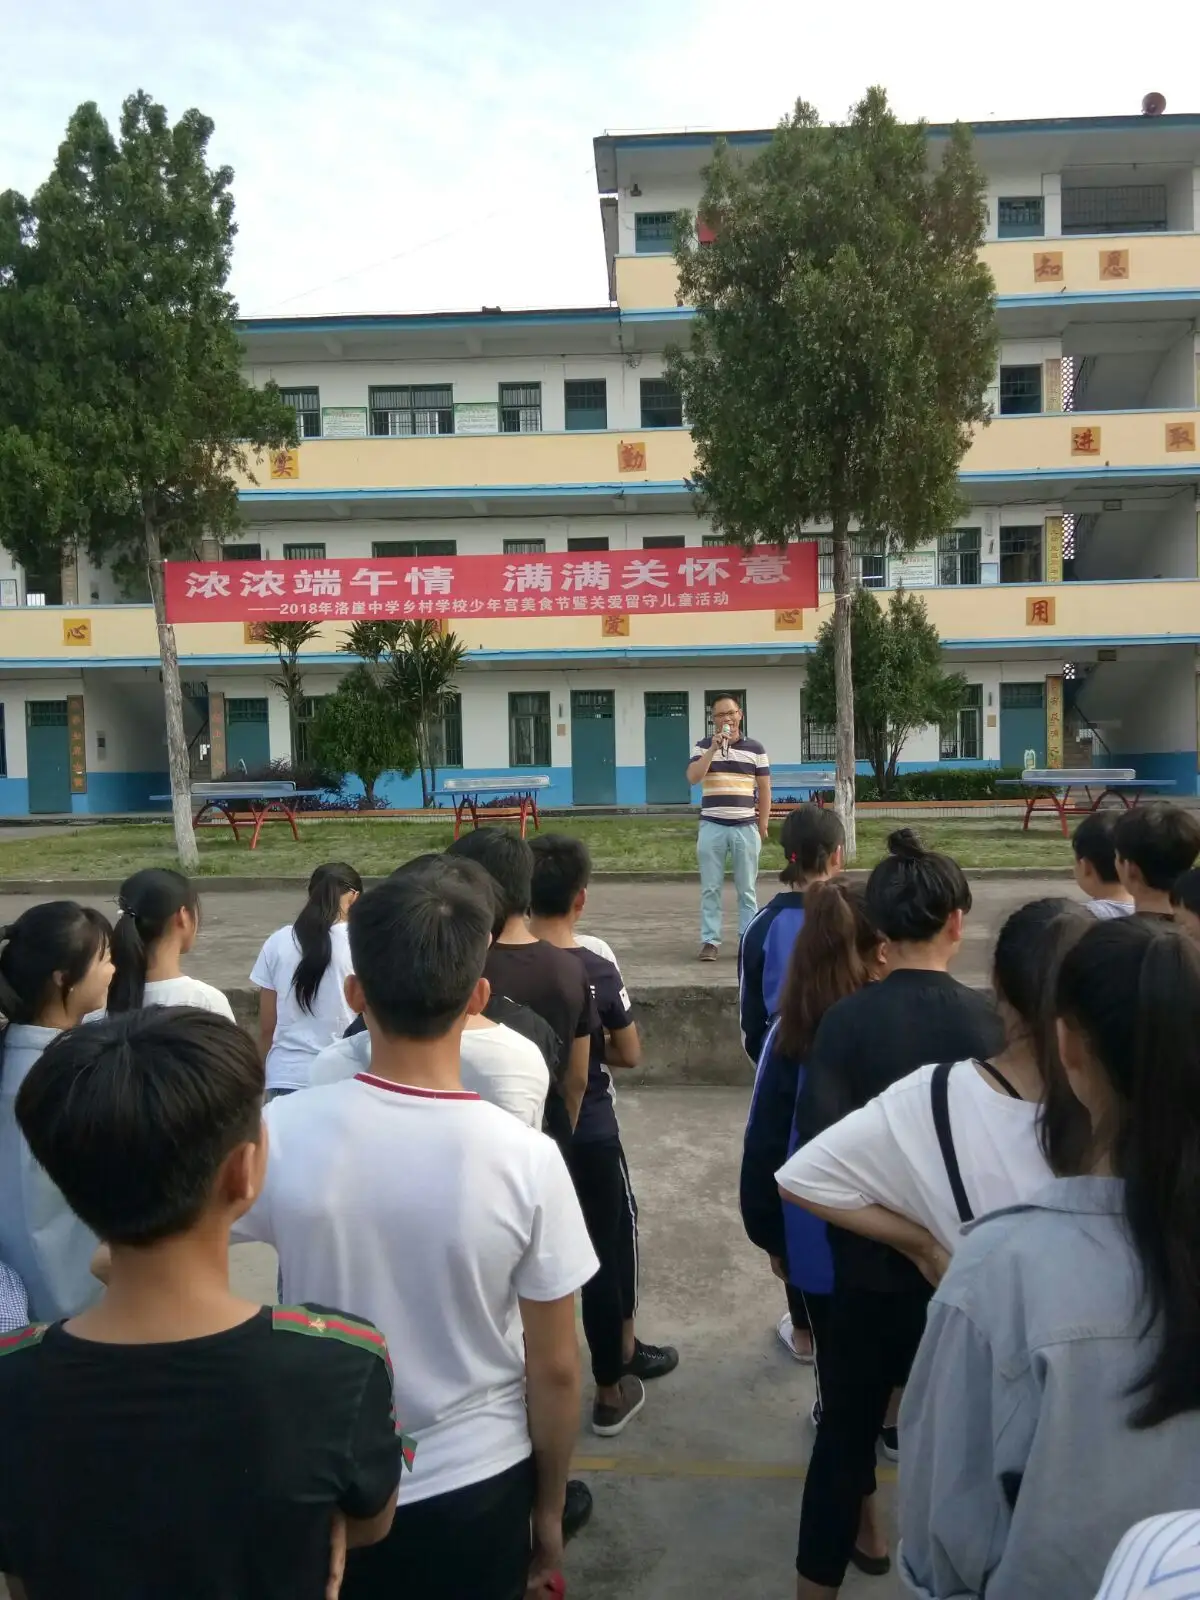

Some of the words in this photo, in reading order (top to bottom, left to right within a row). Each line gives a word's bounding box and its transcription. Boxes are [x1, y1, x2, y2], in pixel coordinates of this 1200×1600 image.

[184, 566, 455, 598] 浓浓端午情
[502, 554, 791, 593] 满满关怀意
[1031, 599, 1050, 624] 用
